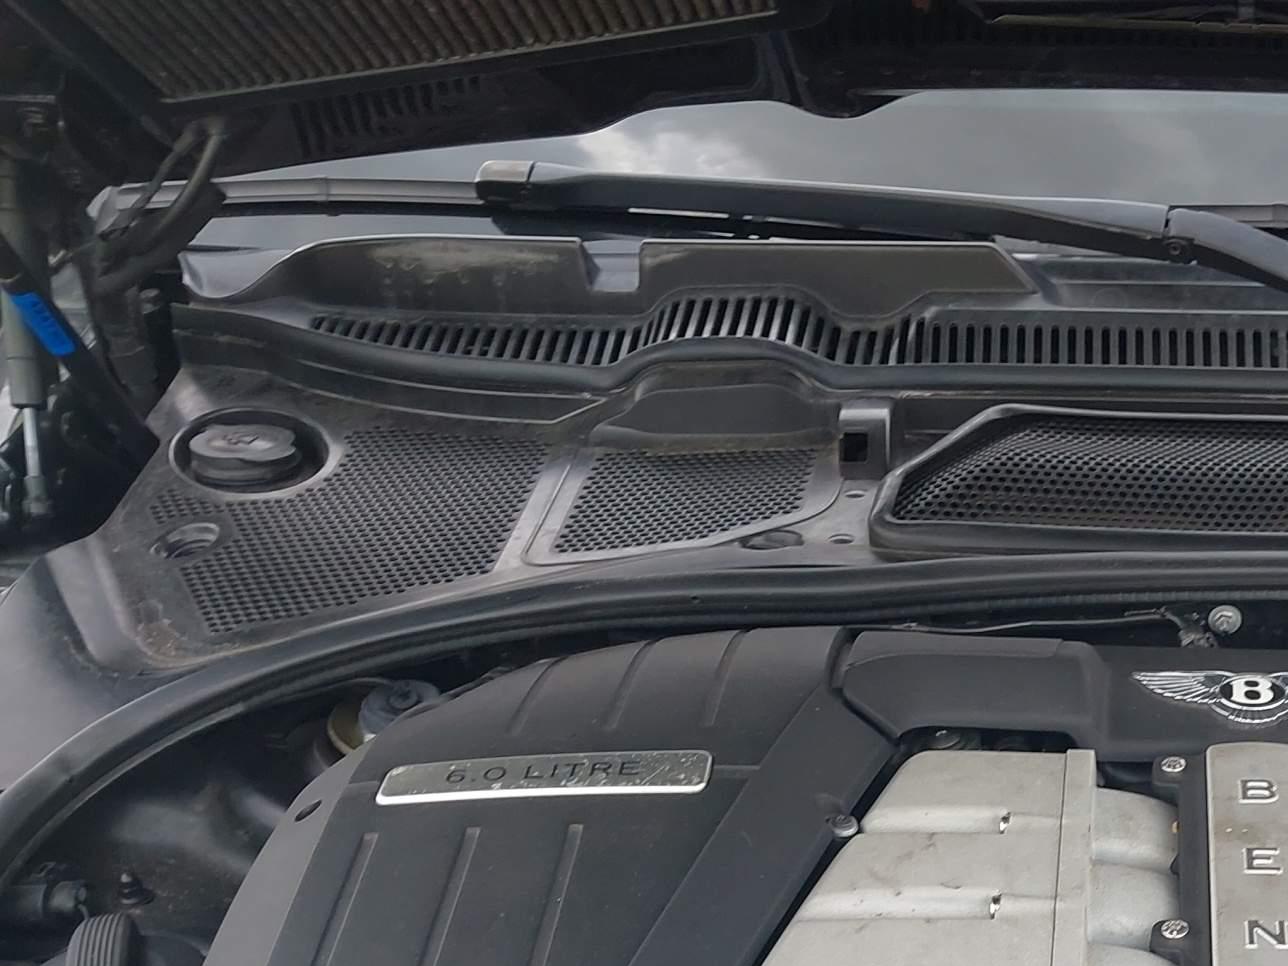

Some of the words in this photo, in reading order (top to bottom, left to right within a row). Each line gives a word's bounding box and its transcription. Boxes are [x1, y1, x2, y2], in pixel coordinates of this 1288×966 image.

[1229, 677, 1275, 704] B
[444, 766, 507, 784] 6.0
[523, 760, 642, 781] LITRE
